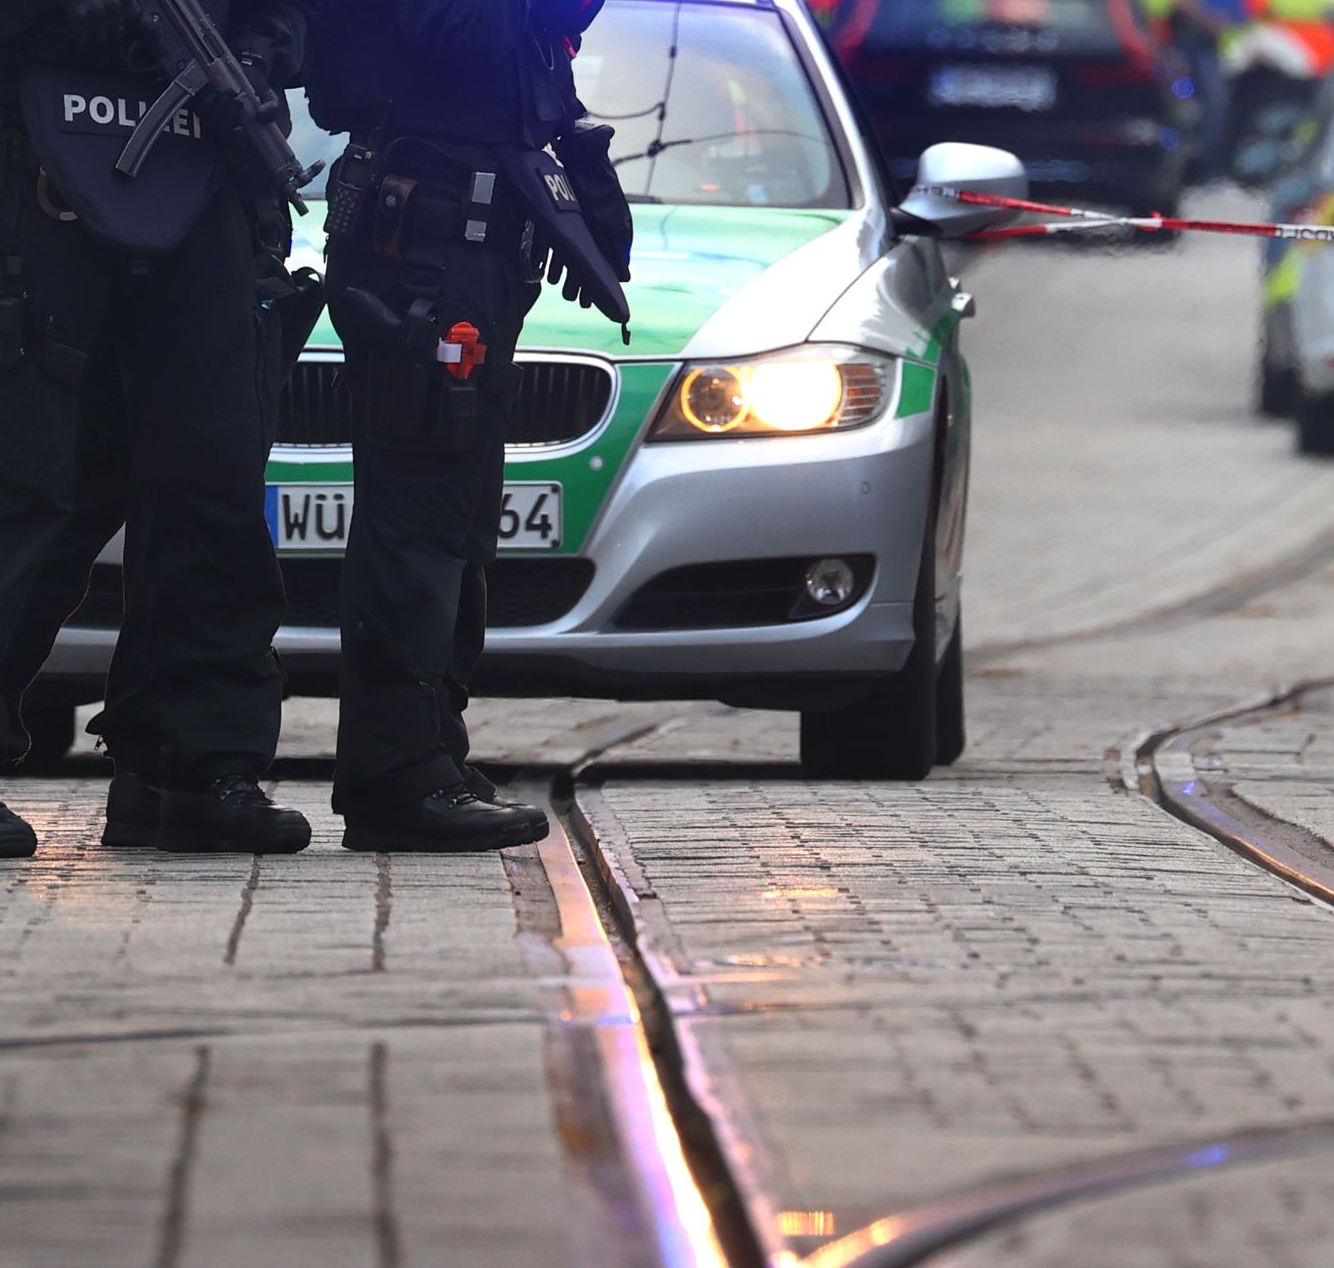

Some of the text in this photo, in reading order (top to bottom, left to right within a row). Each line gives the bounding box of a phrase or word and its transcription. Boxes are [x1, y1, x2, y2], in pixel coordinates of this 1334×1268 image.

[63, 93, 201, 139] POLIEI
[281, 493, 552, 541] WÜ 64
